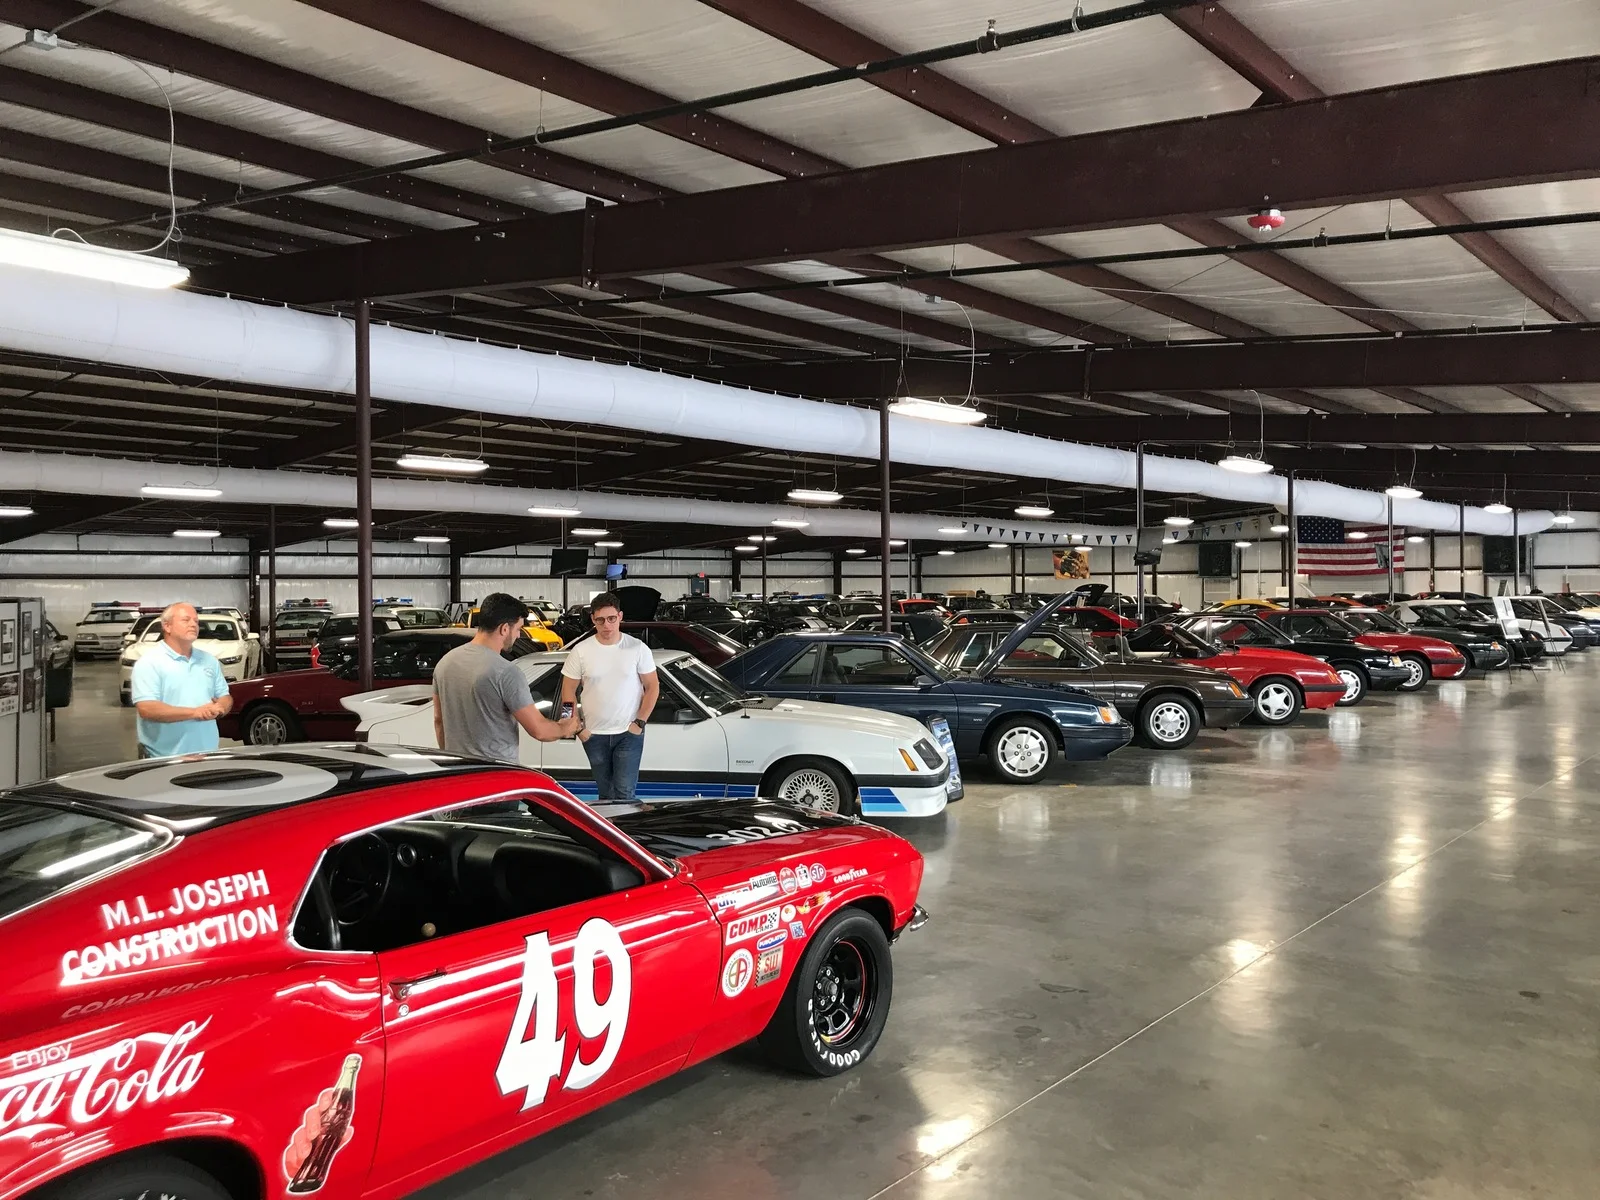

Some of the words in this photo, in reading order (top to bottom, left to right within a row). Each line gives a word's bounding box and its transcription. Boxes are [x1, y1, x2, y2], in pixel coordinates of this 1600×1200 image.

[811, 865, 824, 880] STP
[833, 868, 868, 884] GOODYEAR
[101, 895, 165, 930] M.L.
[168, 869, 270, 915] JOSEPH
[729, 914, 768, 939] COMP
[755, 923, 774, 934] CAMS
[61, 904, 279, 982] CONSTRUCTION
[494, 917, 633, 1113] 49
[12, 1042, 72, 1070] Enjoy
[0, 1014, 213, 1130] ca-Cola
